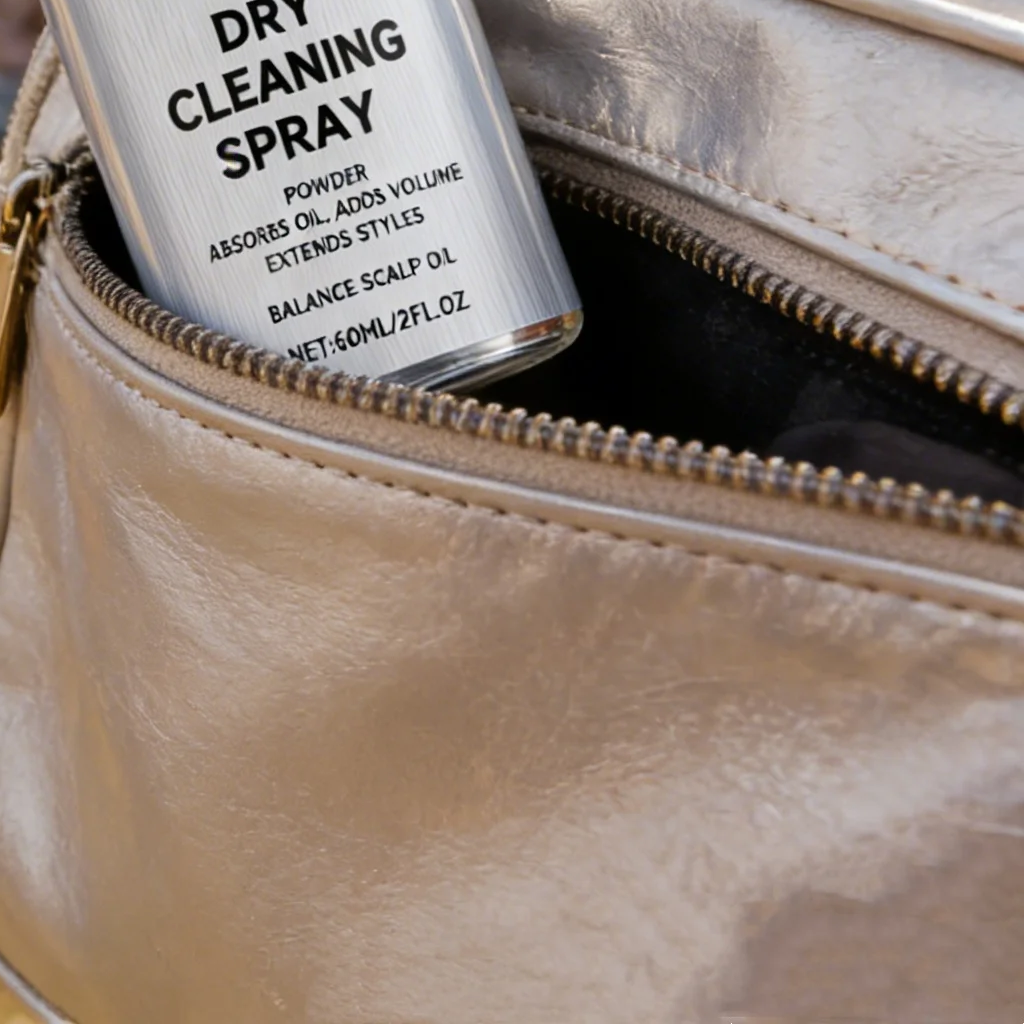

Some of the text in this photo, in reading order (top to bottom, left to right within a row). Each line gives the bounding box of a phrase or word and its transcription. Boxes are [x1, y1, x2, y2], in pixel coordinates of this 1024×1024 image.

[168, 19, 406, 131] CLEANING
[216, 88, 372, 179] SPRAY
[284, 164, 369, 205] POWDER
[265, 206, 425, 273] EXTENDS STYLES
[268, 278, 358, 324] BALANCE
[360, 257, 421, 291] SCALP
